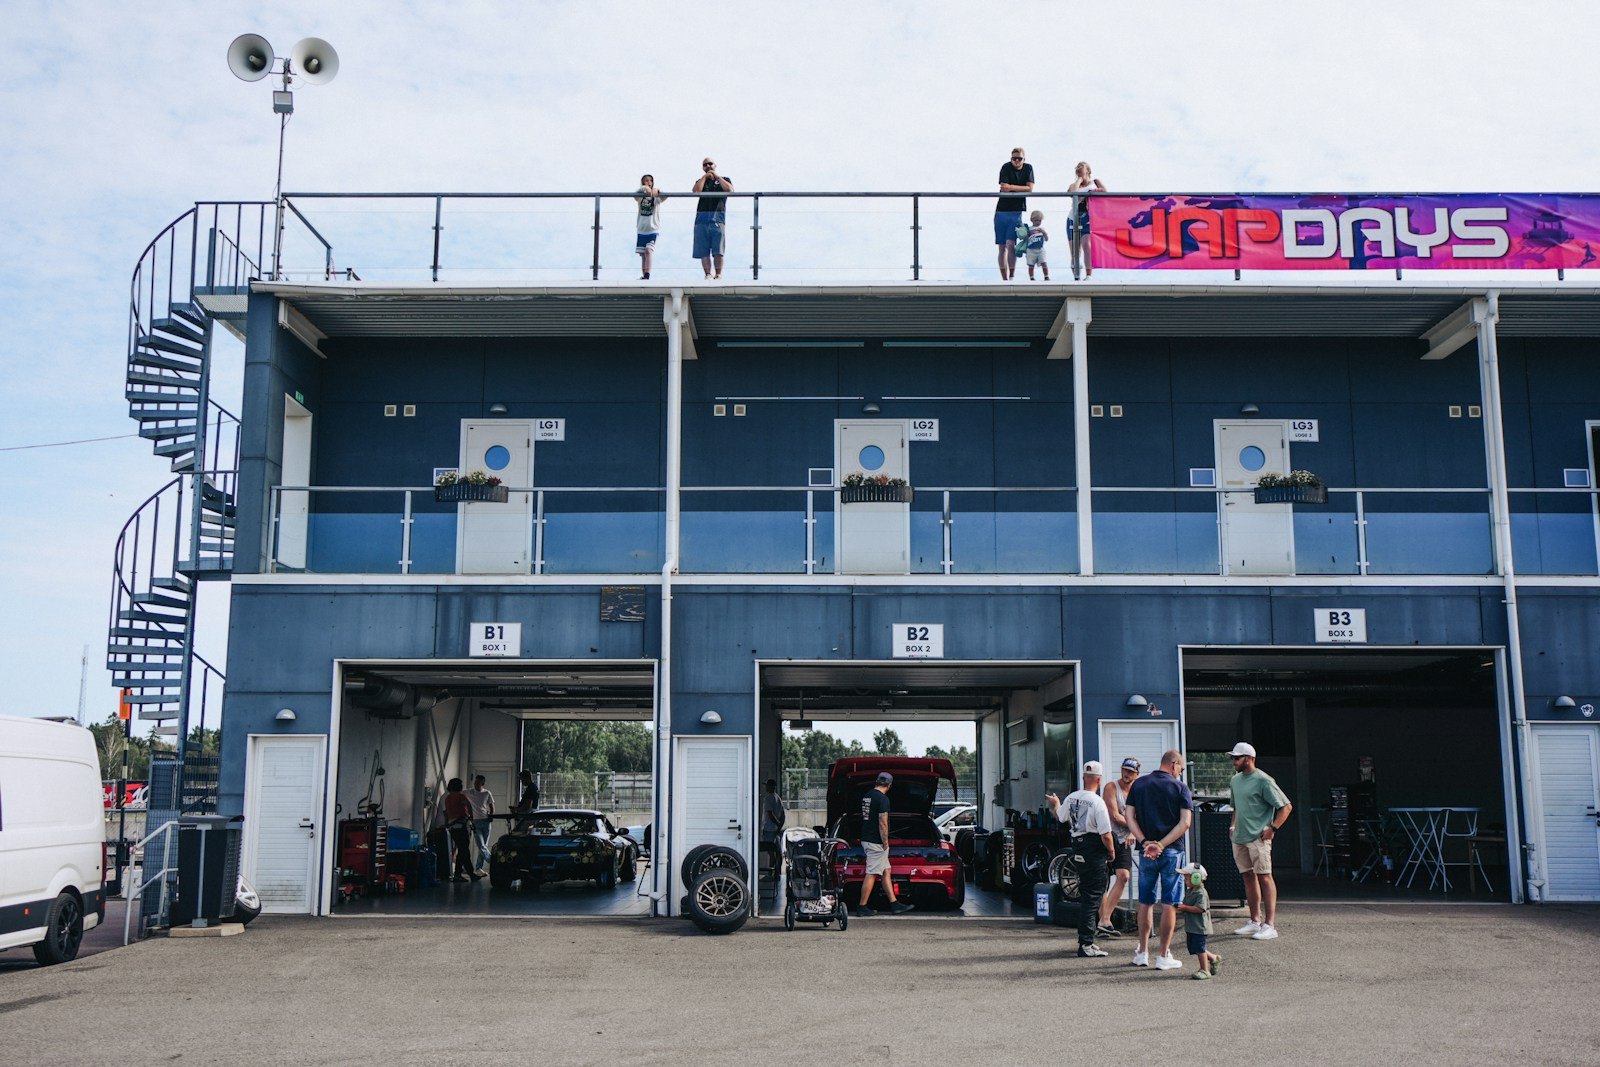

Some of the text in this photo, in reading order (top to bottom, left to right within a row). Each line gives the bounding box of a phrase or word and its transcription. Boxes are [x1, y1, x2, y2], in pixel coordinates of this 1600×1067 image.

[540, 421, 559, 429] LG1
[913, 421, 934, 429] LG2
[1292, 421, 1314, 430] LG3
[1329, 611, 1352, 626] B3
[484, 625, 504, 640] B1
[907, 626, 929, 641] B2
